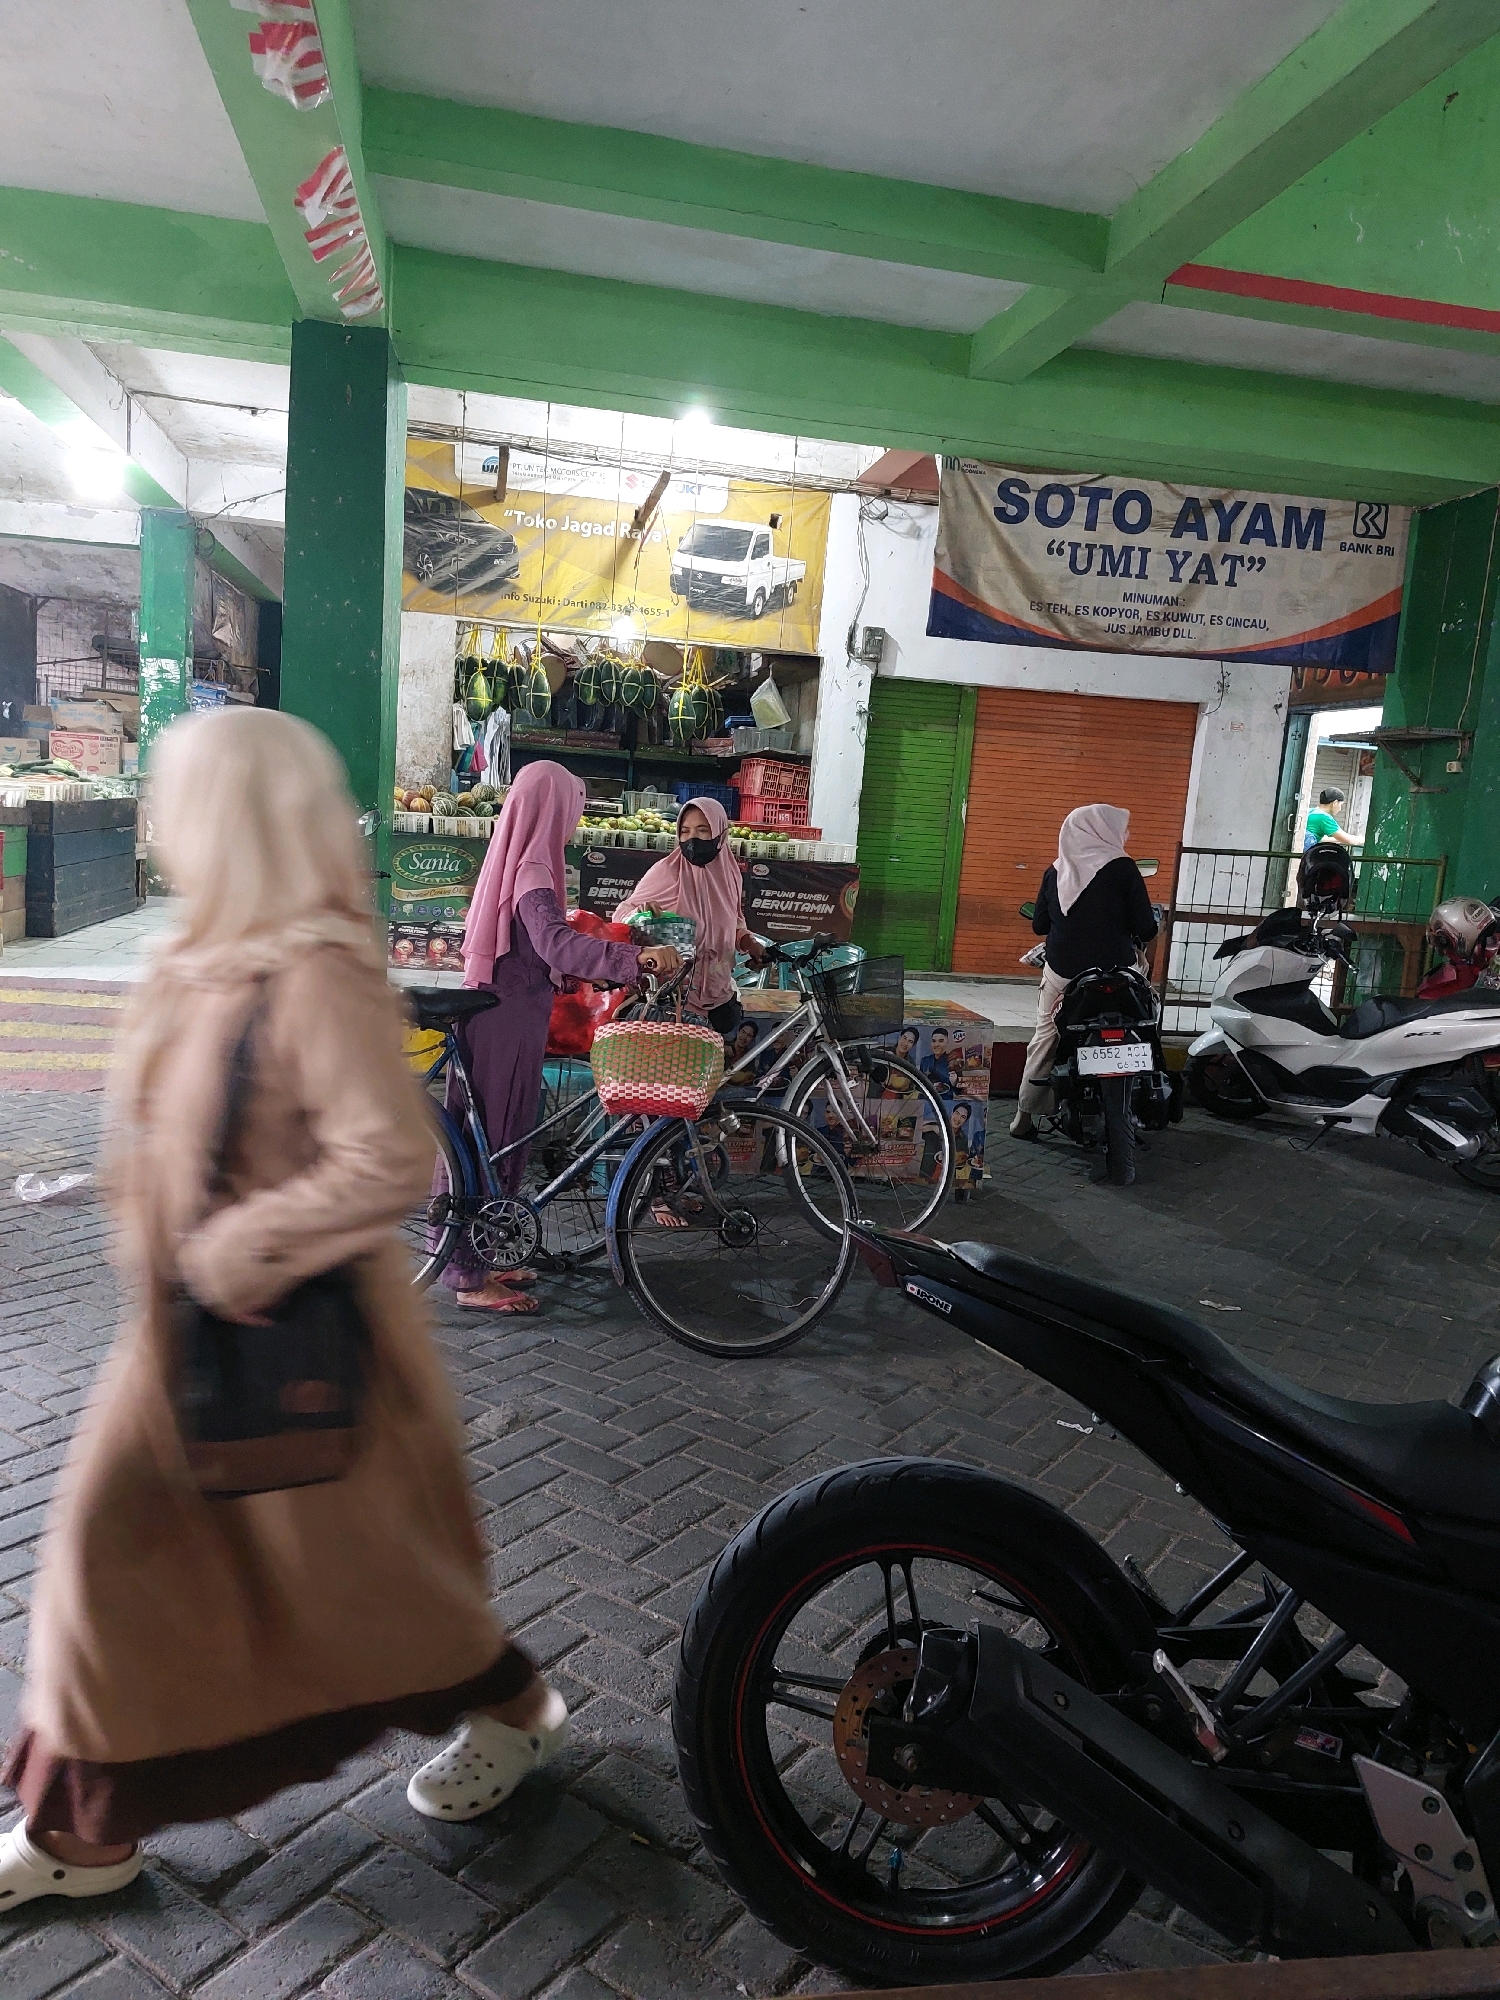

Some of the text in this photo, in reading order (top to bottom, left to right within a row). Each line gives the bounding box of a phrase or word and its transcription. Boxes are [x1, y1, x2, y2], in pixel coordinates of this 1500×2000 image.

[993, 478, 1326, 551] SOTO AYAM
[503, 509, 558, 530] “Toko
[561, 515, 616, 538] Jagad
[1340, 541, 1395, 557] BANK BRI
[1046, 538, 1267, 588] “UMI YAT”
[522, 593, 556, 606] Suzuki
[563, 598, 588, 609] Darti
[1122, 591, 1179, 607] MINUMAN
[1029, 600, 1270, 632] ES TEH, ES KOPYOR, ES KUWUT, ES CINCAU,
[1103, 622, 1197, 640] JUS JAMBU DLL.
[408, 852, 462, 872] Sania
[596, 877, 635, 887] TEPUNG
[760, 889, 830, 902] TEPUNG BUMBU
[751, 898, 836, 914] BERVITAMIN
[1080, 1050, 1088, 1060] S
[1092, 1047, 1121, 1059] 6552
[916, 1288, 952, 1312] IPONE
